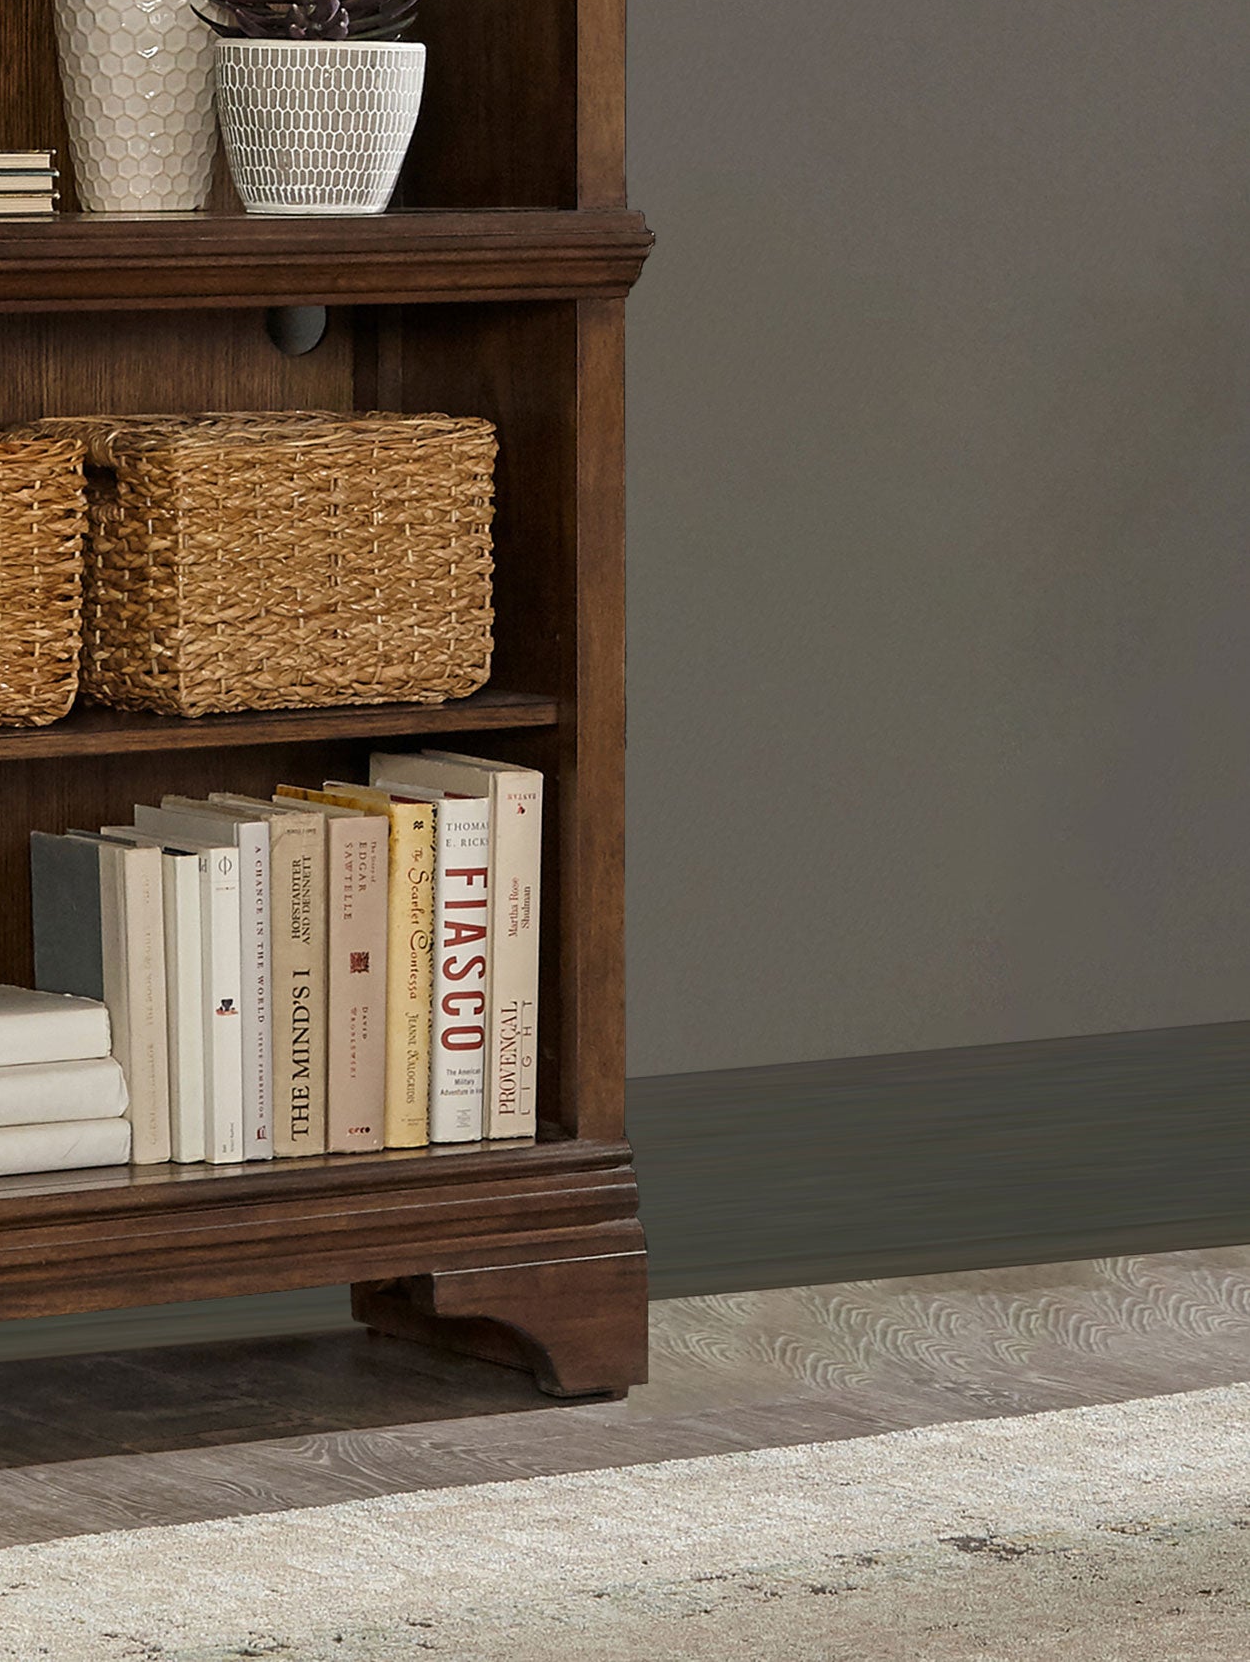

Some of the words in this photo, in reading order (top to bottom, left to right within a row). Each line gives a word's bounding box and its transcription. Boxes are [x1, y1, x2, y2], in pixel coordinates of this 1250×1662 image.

[359, 842, 367, 892] EDGAR
[446, 838, 456, 848] E.
[255, 860, 263, 915] CHANCE
[291, 858, 301, 940] HOFSTADTER
[301, 855, 311, 914] DENNETT
[344, 842, 353, 920] SAWTELLE
[408, 867, 429, 926] Scarlet
[508, 876, 519, 901] Rose
[256, 921, 263, 937] IN
[301, 917, 311, 946] AND
[508, 904, 519, 938] Martha
[520, 885, 531, 930] Shulman
[256, 942, 264, 970] THE
[292, 968, 310, 979] I
[408, 929, 429, 1001] Contessa
[441, 866, 488, 1051] FIASCO
[257, 975, 265, 1024] WORLD
[405, 1011, 418, 1046] JEANNE
[498, 1001, 521, 1115] PROVENÇAL
[521, 1000, 532, 1115] LIGHT
[291, 1086, 310, 1142] THE
